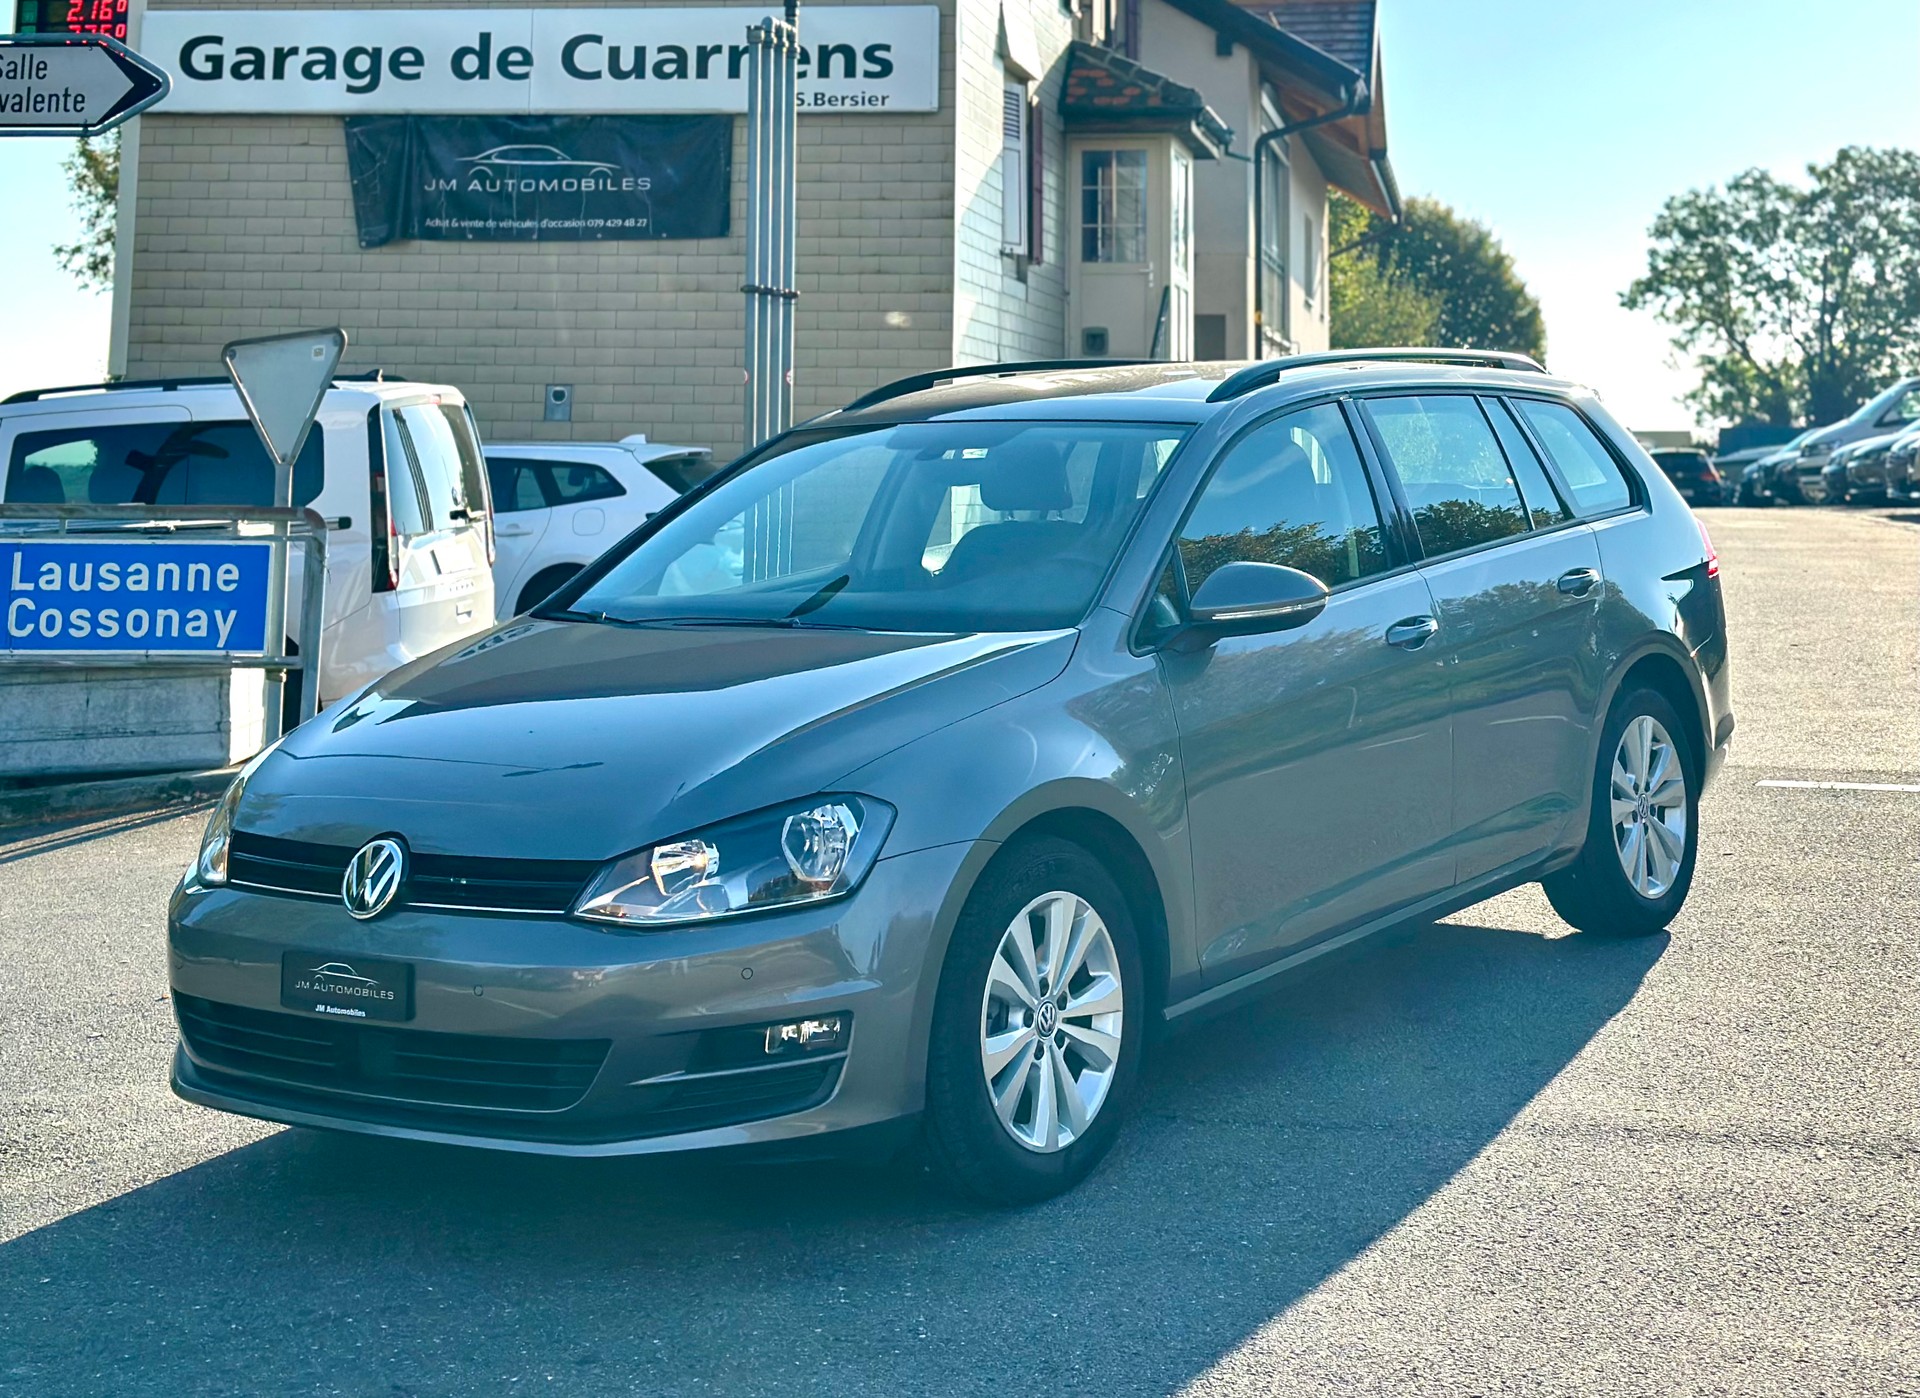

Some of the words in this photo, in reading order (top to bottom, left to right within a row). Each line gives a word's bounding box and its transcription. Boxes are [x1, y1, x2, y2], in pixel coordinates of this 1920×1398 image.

[179, 35, 425, 94] Garage
[450, 32, 534, 80] de
[424, 179, 457, 191] JM
[467, 177, 652, 193] AUTOMOBILES
[425, 218, 449, 228] Achat
[451, 218, 459, 228] &
[460, 218, 485, 228] vente
[486, 218, 497, 229] de
[540, 218, 586, 229] d'occasion
[587, 218, 605, 228] 079
[606, 218, 623, 228] 429
[623, 218, 636, 228] 48
[636, 218, 648, 228] 27
[11, 551, 240, 592] Lausanne
[8, 597, 238, 648] Cossonay
[295, 980, 310, 989] JM
[314, 982, 395, 1000] AUTOMOBILES
[315, 1004, 325, 1013] JM
[326, 1005, 366, 1017] Automobiles
